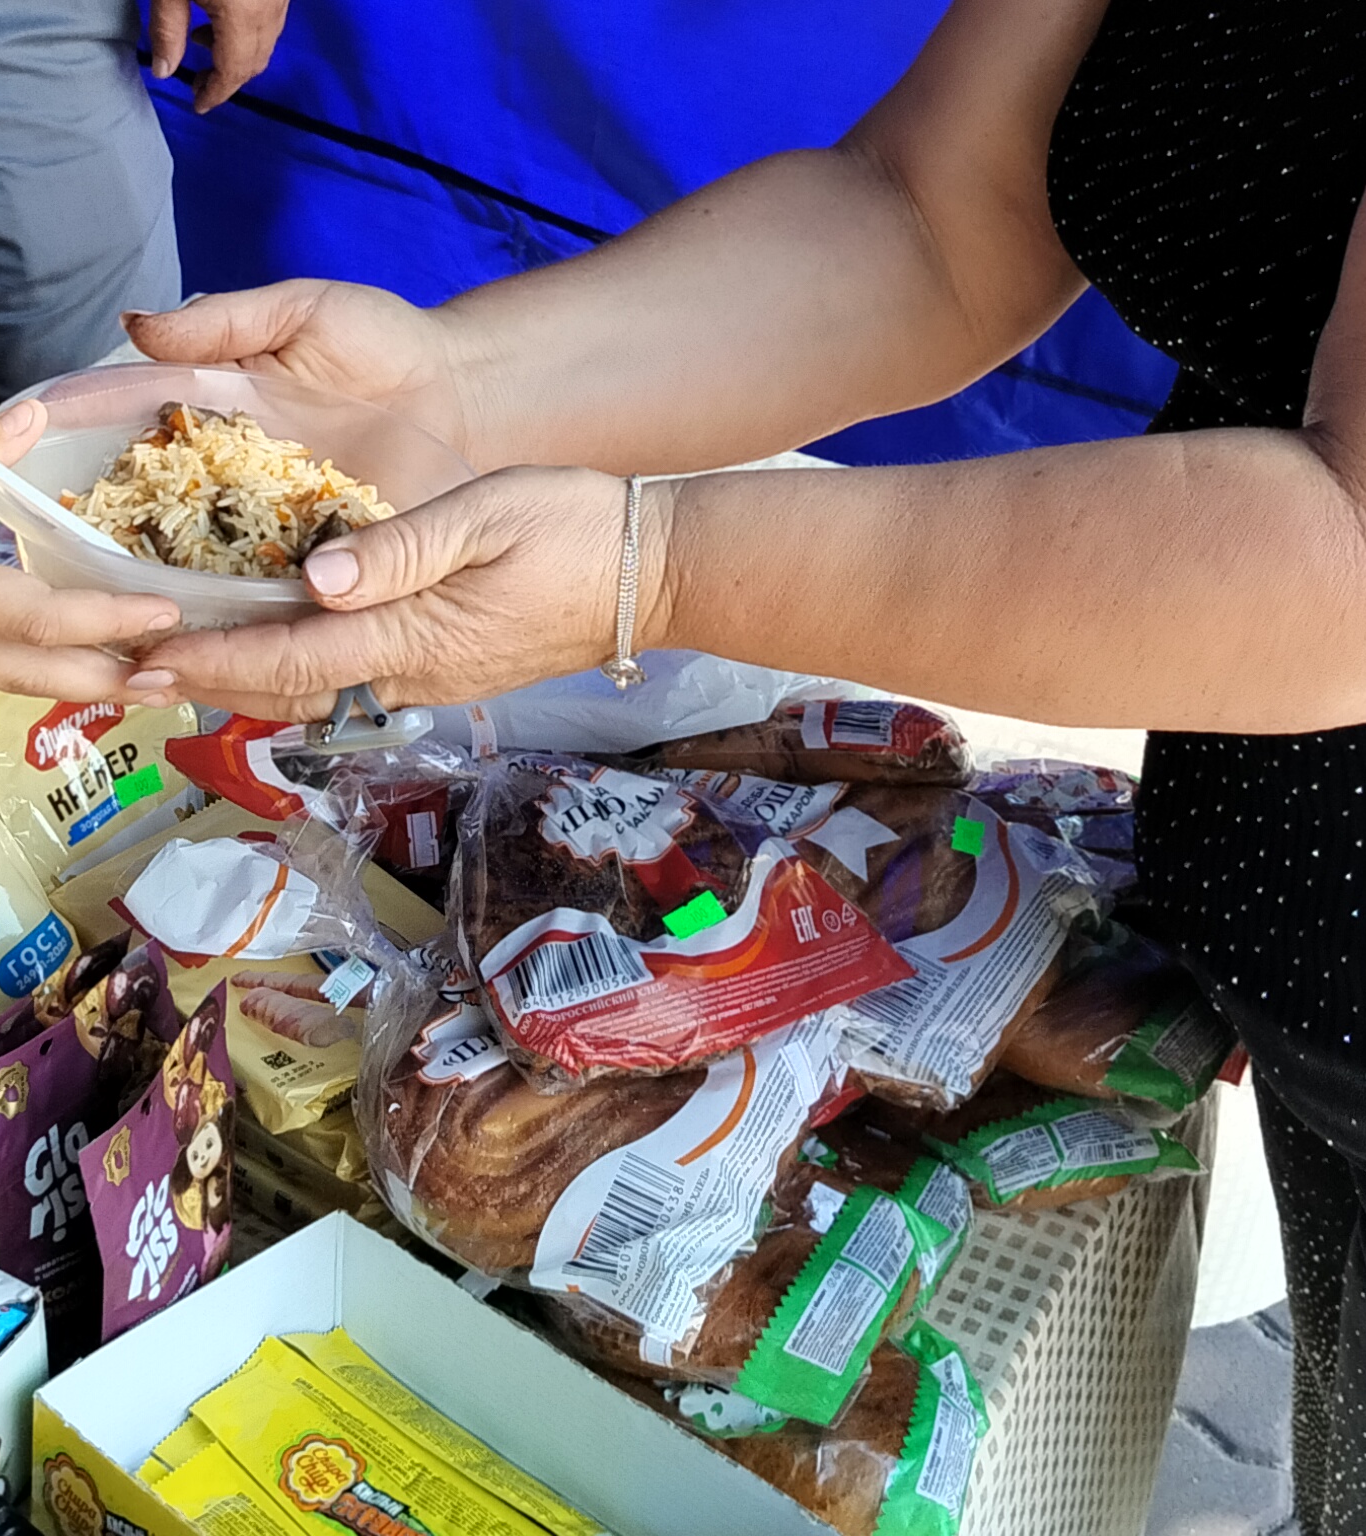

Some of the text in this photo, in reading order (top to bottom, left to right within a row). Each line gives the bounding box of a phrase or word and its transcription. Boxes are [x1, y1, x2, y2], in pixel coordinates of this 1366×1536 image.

[7, 920, 61, 978] ГОСТ
[296, 1454, 335, 1495] Chups
[312, 1447, 350, 1485] Chupa
[57, 1478, 97, 1520] Chupa
